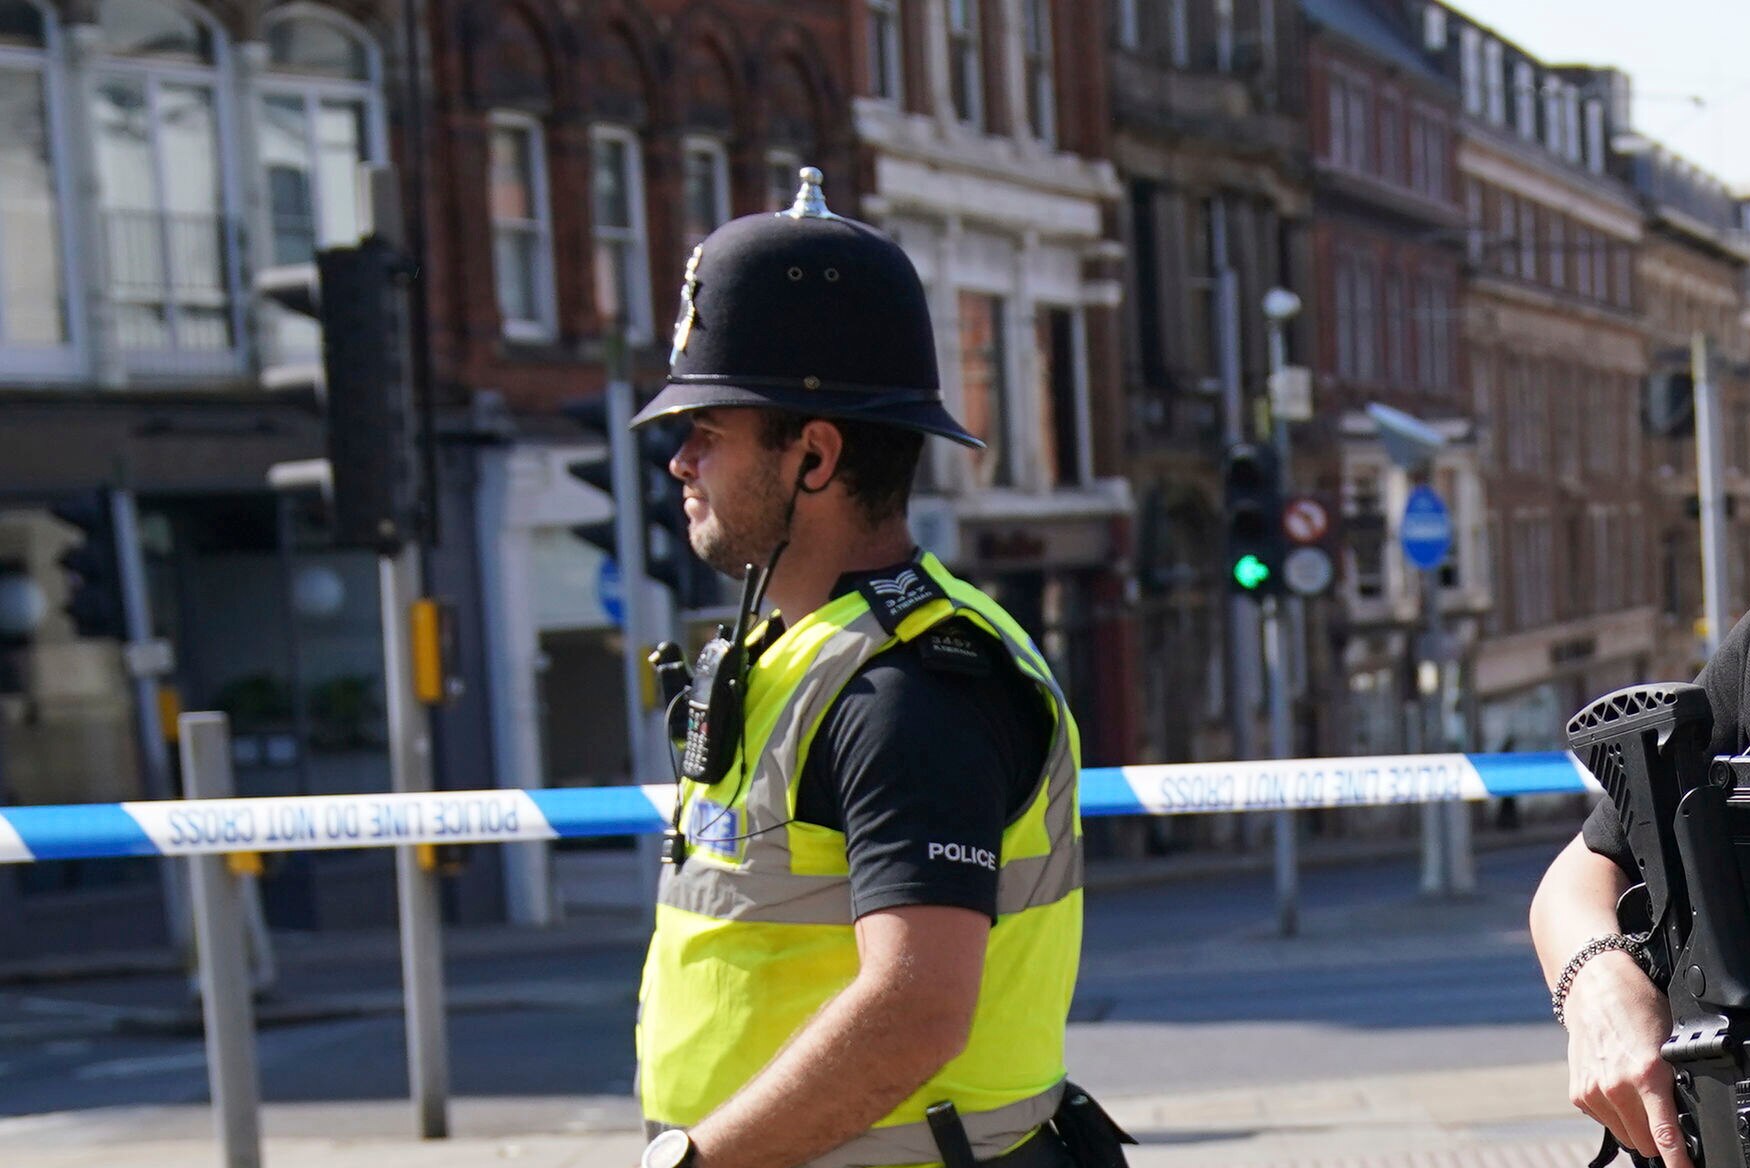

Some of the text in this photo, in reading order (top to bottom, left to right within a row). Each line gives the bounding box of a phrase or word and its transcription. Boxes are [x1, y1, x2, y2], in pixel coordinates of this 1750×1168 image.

[1160, 764, 1462, 809] POLICE LINE DO NOT CROSS
[169, 800, 519, 845] POLICE LINE DO NOT CROSS
[928, 841, 997, 872] POLICE
